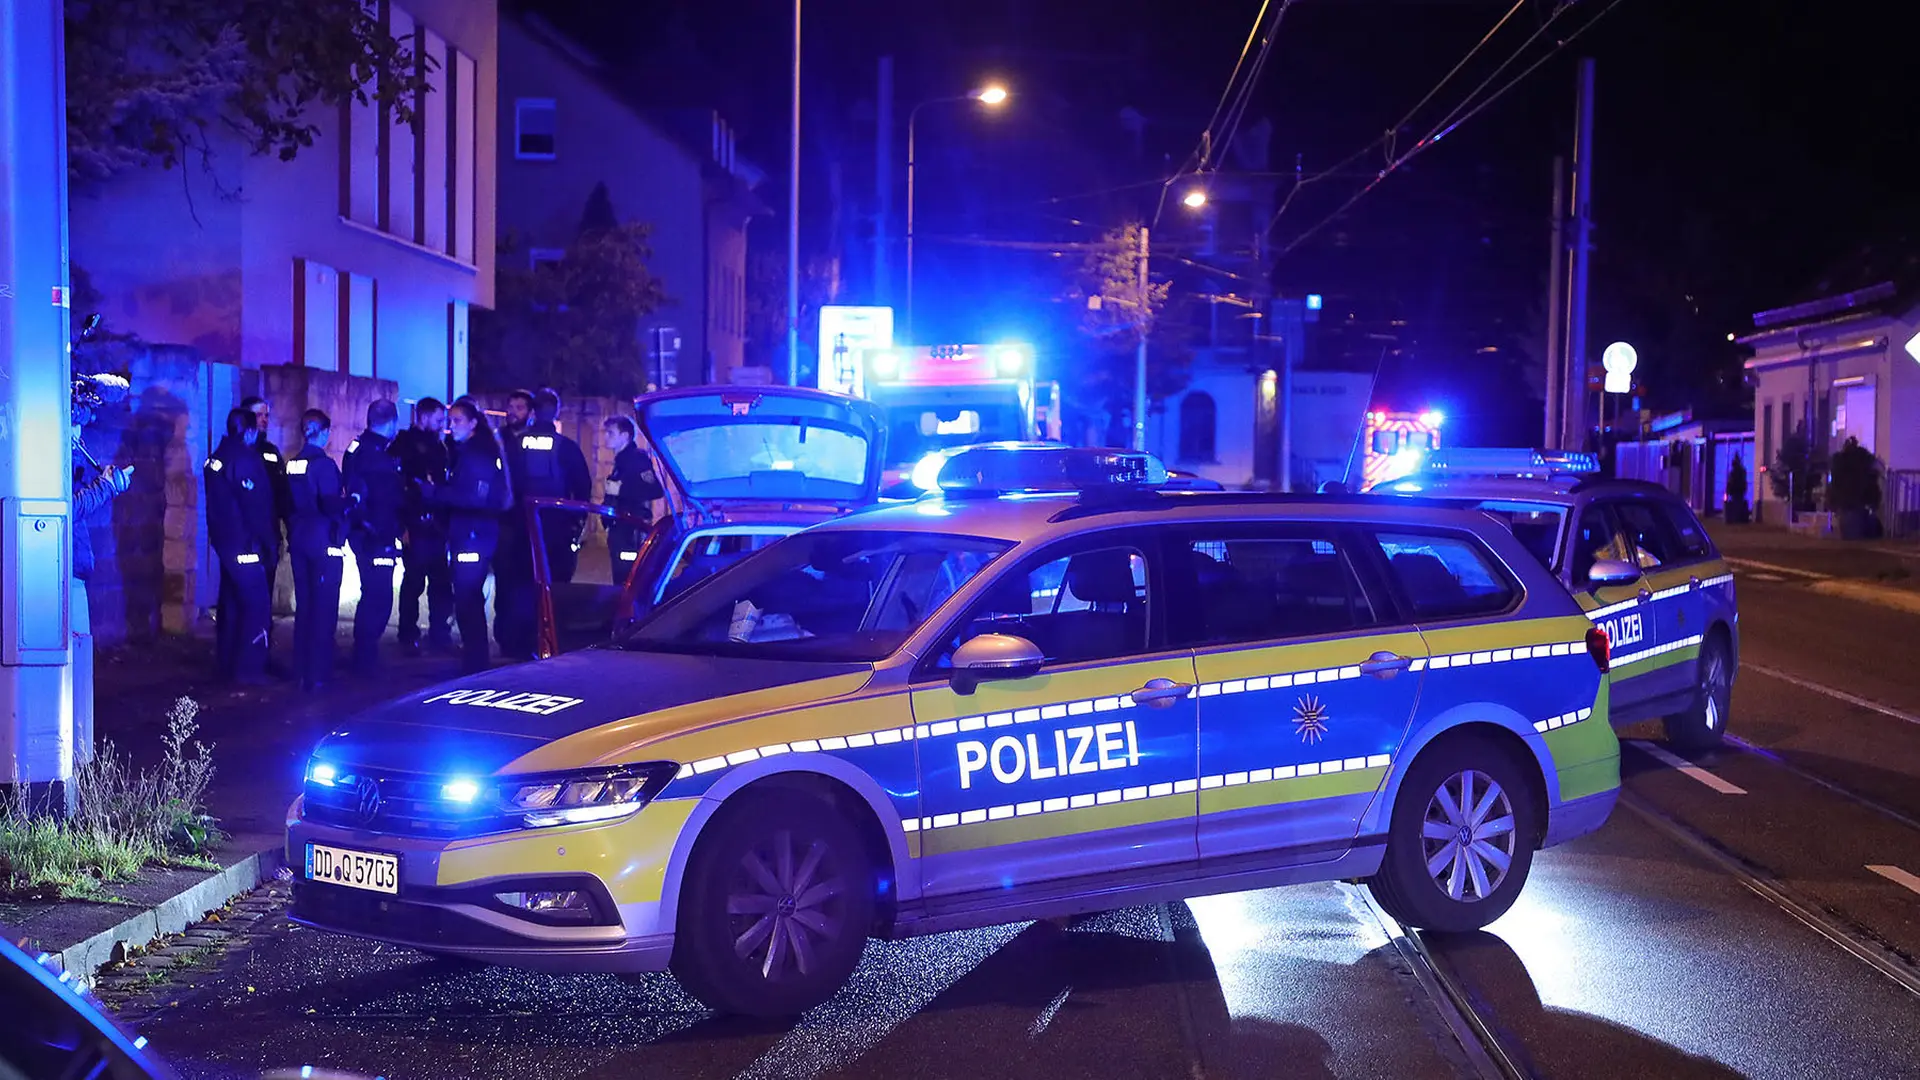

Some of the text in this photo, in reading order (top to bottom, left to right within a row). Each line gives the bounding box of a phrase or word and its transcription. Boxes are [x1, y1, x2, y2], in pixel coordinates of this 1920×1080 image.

[423, 690, 584, 715] POLIZEI
[956, 720, 1139, 789] POLIZEI
[315, 849, 332, 878] DD
[355, 856, 395, 888] 5703
